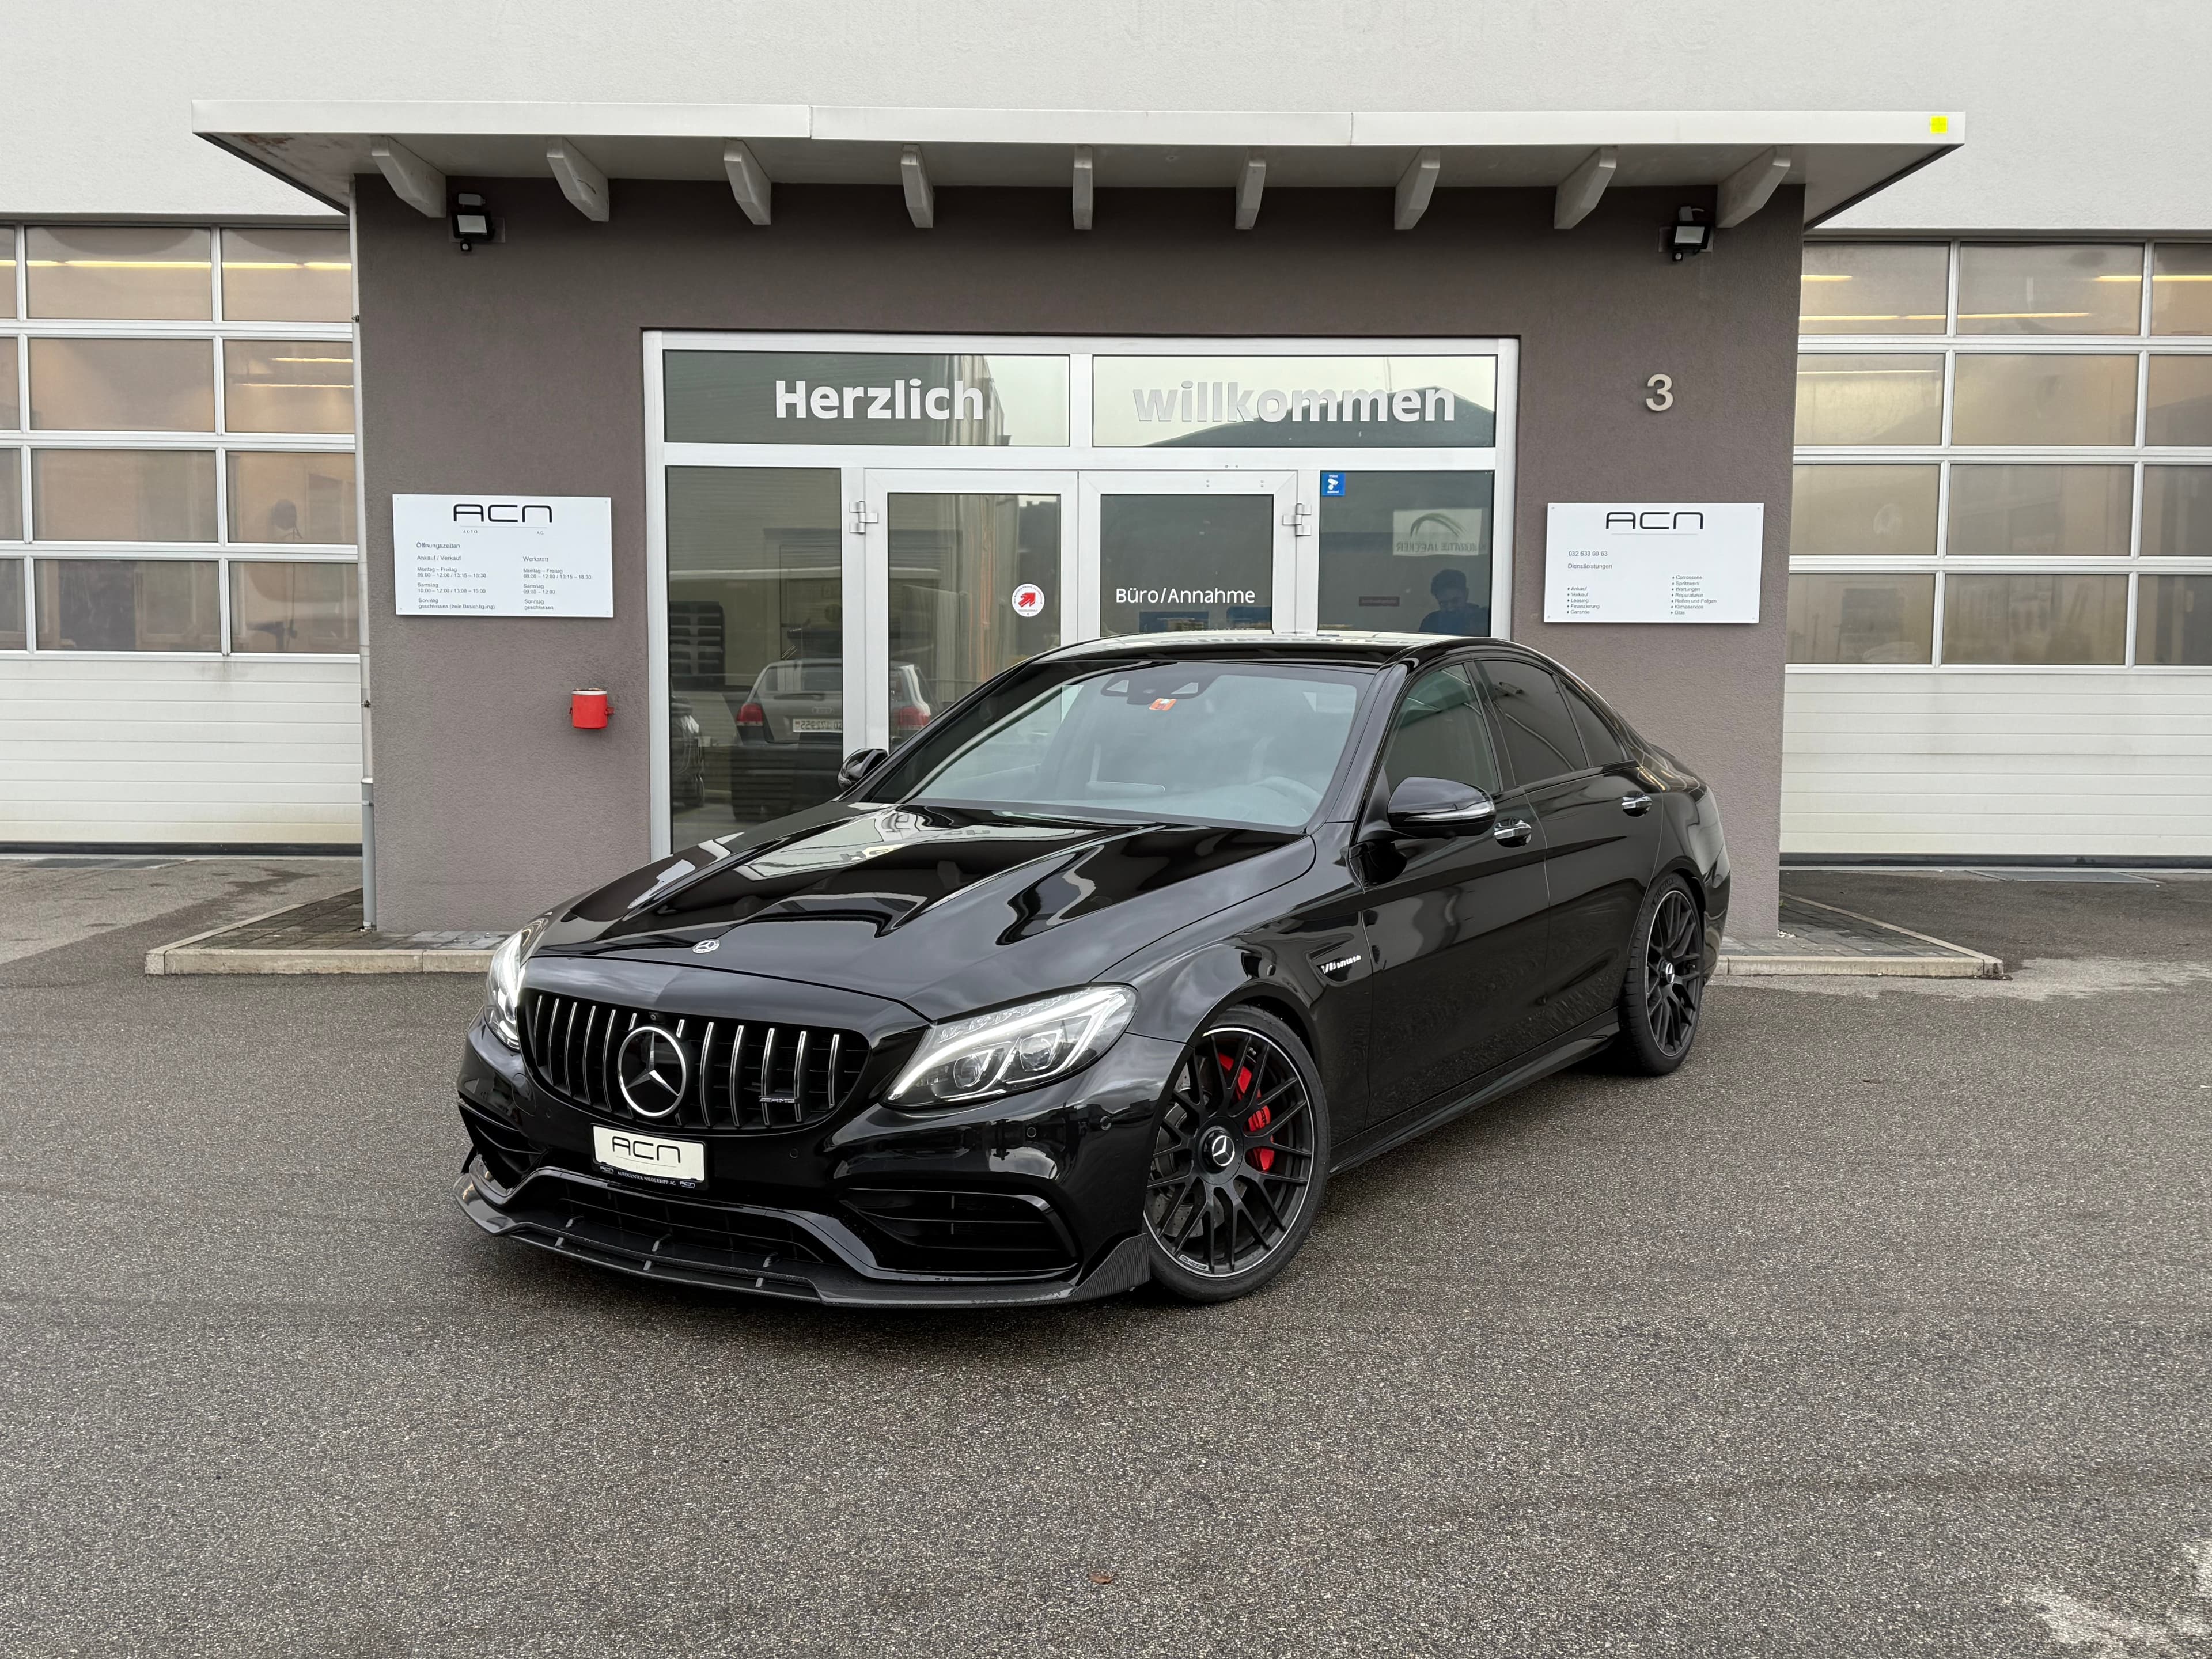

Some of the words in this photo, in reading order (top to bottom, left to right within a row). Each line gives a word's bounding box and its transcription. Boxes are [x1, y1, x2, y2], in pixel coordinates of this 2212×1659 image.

[775, 378, 984, 420] Herzlich
[1132, 380, 1455, 422] willkommen
[1646, 373, 1673, 411] 3
[453, 503, 552, 523] ACN
[1605, 512, 1704, 530] ACN
[416, 541, 460, 550] Öffnungszeiten
[1115, 587, 1256, 604] Büro/Annahme
[612, 1135, 681, 1164] ACN
[617, 1171, 643, 1180] AUTOCENTER
